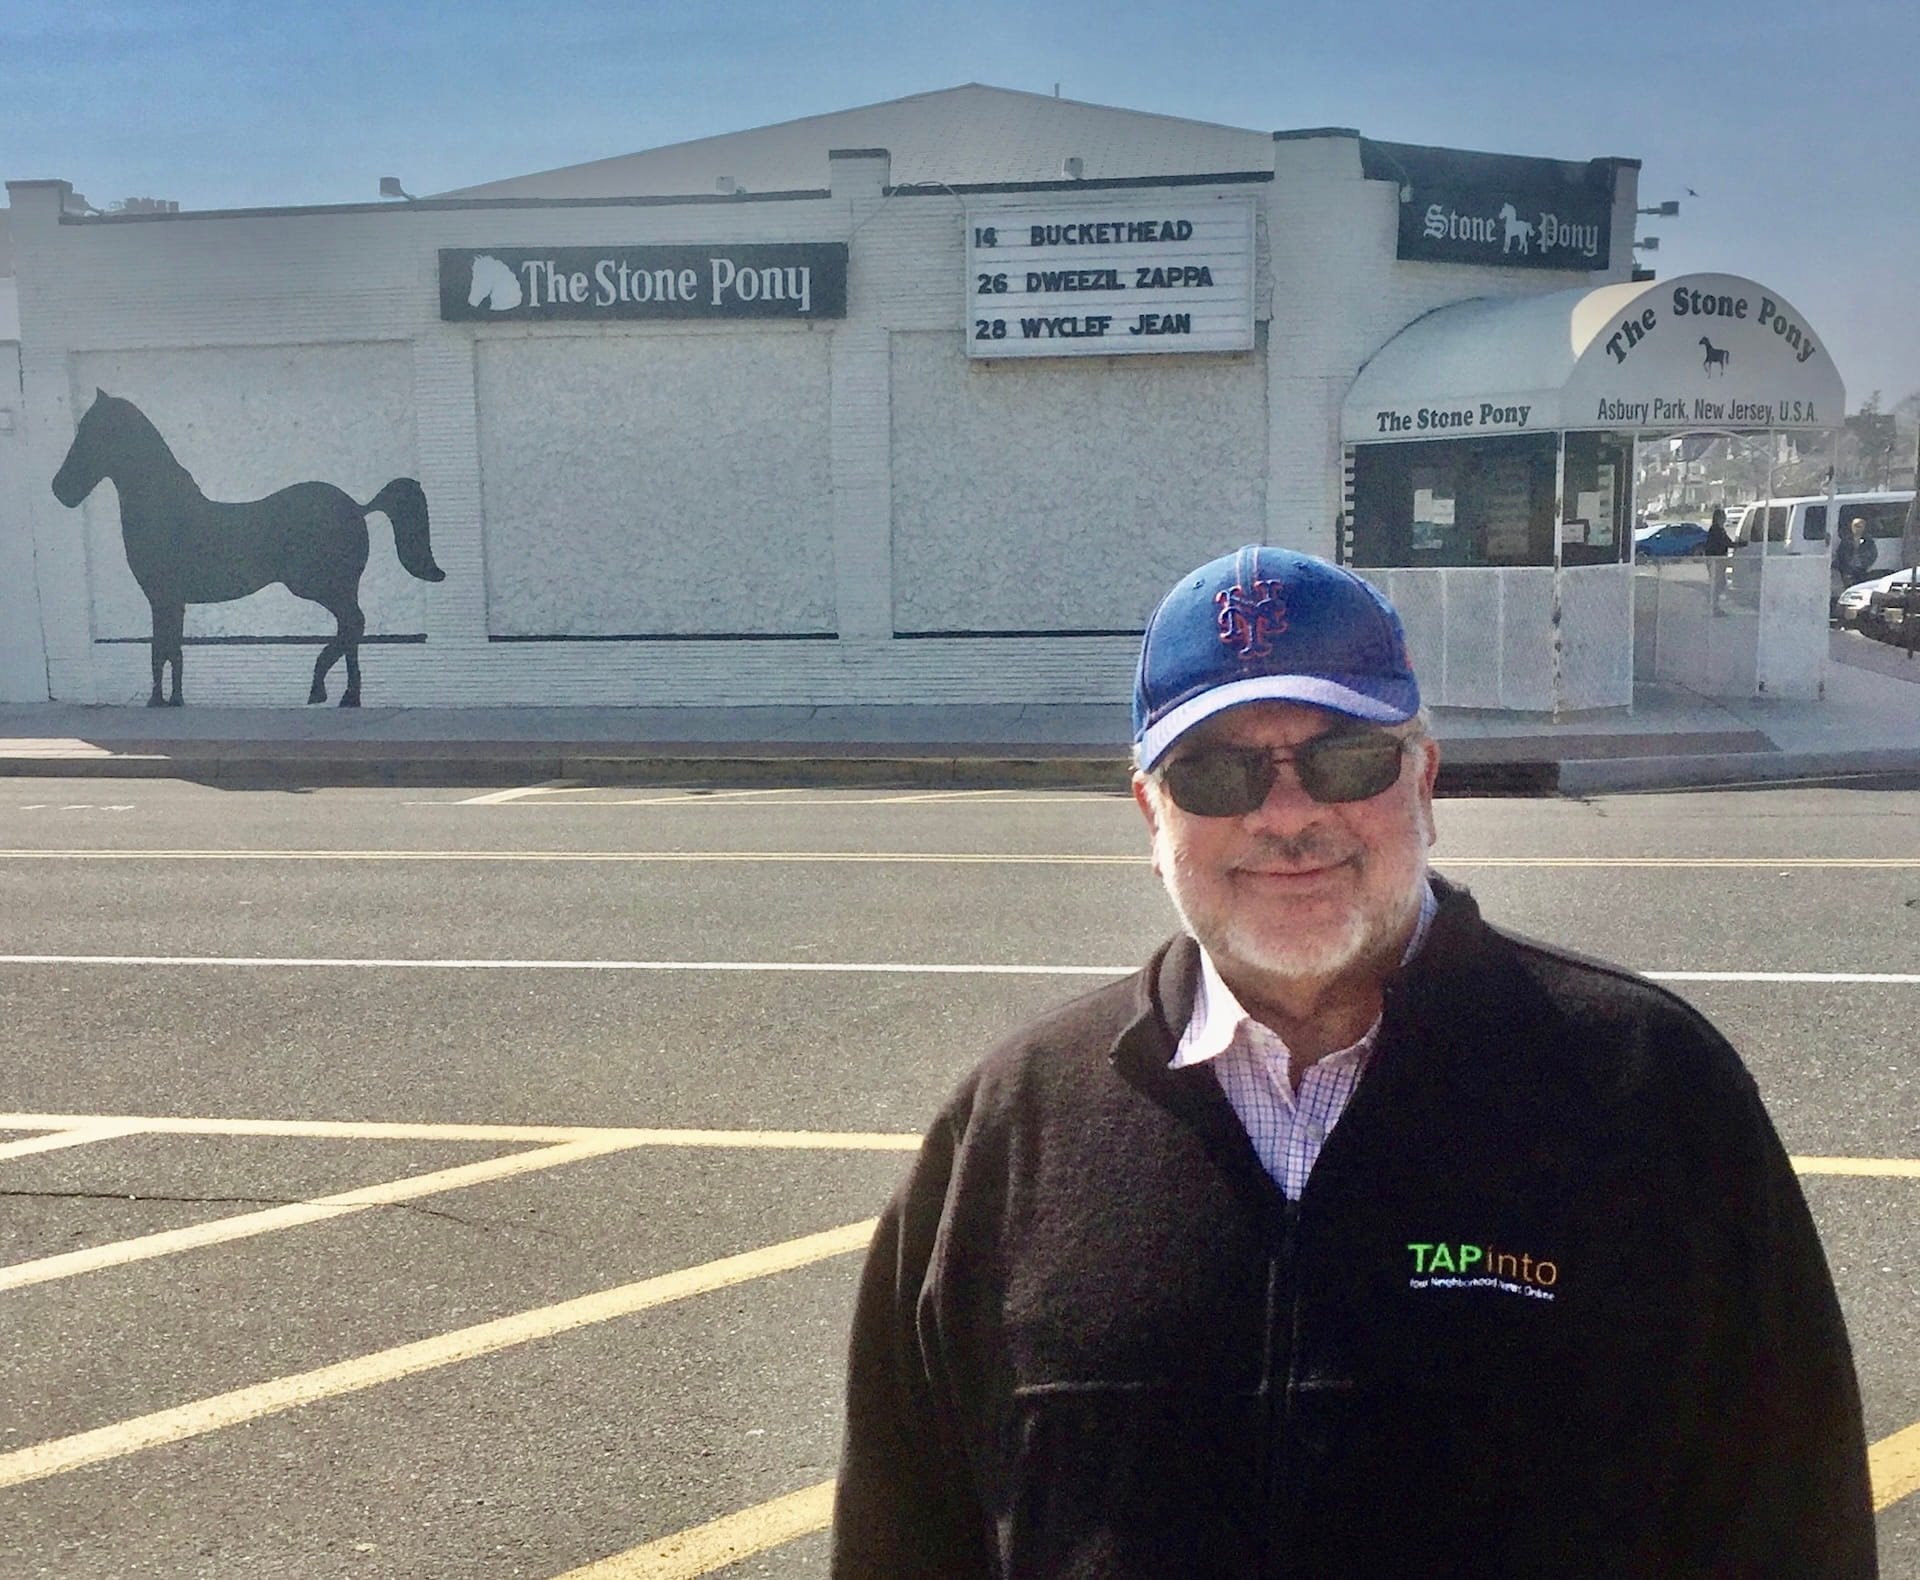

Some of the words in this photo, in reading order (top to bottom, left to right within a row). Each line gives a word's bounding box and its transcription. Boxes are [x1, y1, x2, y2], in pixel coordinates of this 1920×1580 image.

[975, 227, 998, 248] 14
[1030, 220, 1193, 246] BUCKETHEAD
[1423, 204, 1497, 243] Stone
[1536, 212, 1599, 257] Pony
[522, 260, 589, 307] The
[595, 258, 697, 307] Stone
[709, 258, 810, 311] Pony
[977, 273, 1008, 294] 26
[1026, 269, 1126, 293] DWEEZIL
[1136, 266, 1214, 289] ZAPPA
[975, 319, 1006, 340] 28
[1020, 315, 1112, 338] WYCLEF
[1129, 313, 1191, 335] JEAN
[1606, 308, 1657, 364] The
[1673, 287, 1748, 319] Stone
[1758, 297, 1816, 363] Pony
[1377, 411, 1412, 432] The
[1417, 408, 1473, 429] Stone
[1480, 403, 1531, 427] Pony
[1597, 398, 1649, 424] Asbury
[1654, 398, 1689, 422] Park,
[1694, 399, 1724, 419] New
[1728, 399, 1774, 424] Jersey,
[1779, 401, 1818, 422] U.S.A.
